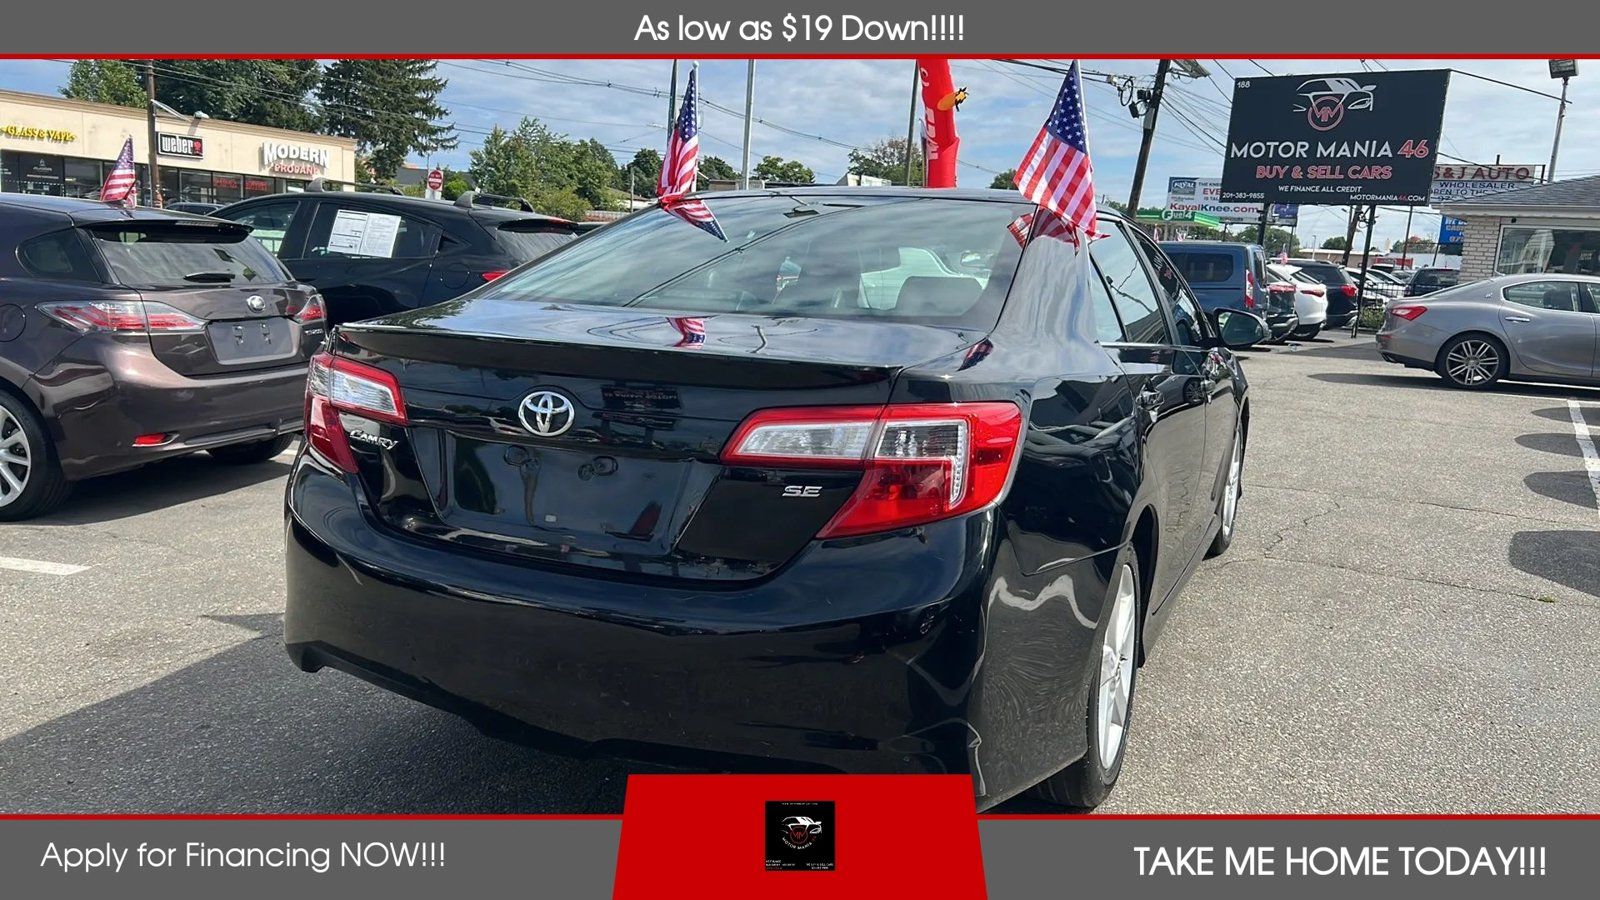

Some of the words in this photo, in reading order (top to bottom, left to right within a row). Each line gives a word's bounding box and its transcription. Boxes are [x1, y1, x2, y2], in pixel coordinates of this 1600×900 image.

[7, 125, 37, 138] GLASS
[37, 129, 46, 138] &
[161, 134, 193, 154] weber
[1230, 141, 1308, 159] MOTOR
[1316, 140, 1393, 159] MANIA
[1397, 139, 1429, 159] 46
[263, 142, 330, 168] MODERN
[1256, 165, 1289, 179] BUY
[1291, 165, 1303, 179] &
[1307, 165, 1345, 179] SELL
[1348, 165, 1393, 180] CARS
[1472, 167, 1530, 180] AUTO
[1290, 185, 1320, 193] FINANCE
[1321, 185, 1335, 193] ALL
[1439, 181, 1515, 189] WHOLESALER
[1170, 203, 1258, 213] KayalKnee.com
[350, 430, 398, 449] CAMRY
[782, 485, 822, 497] SE
